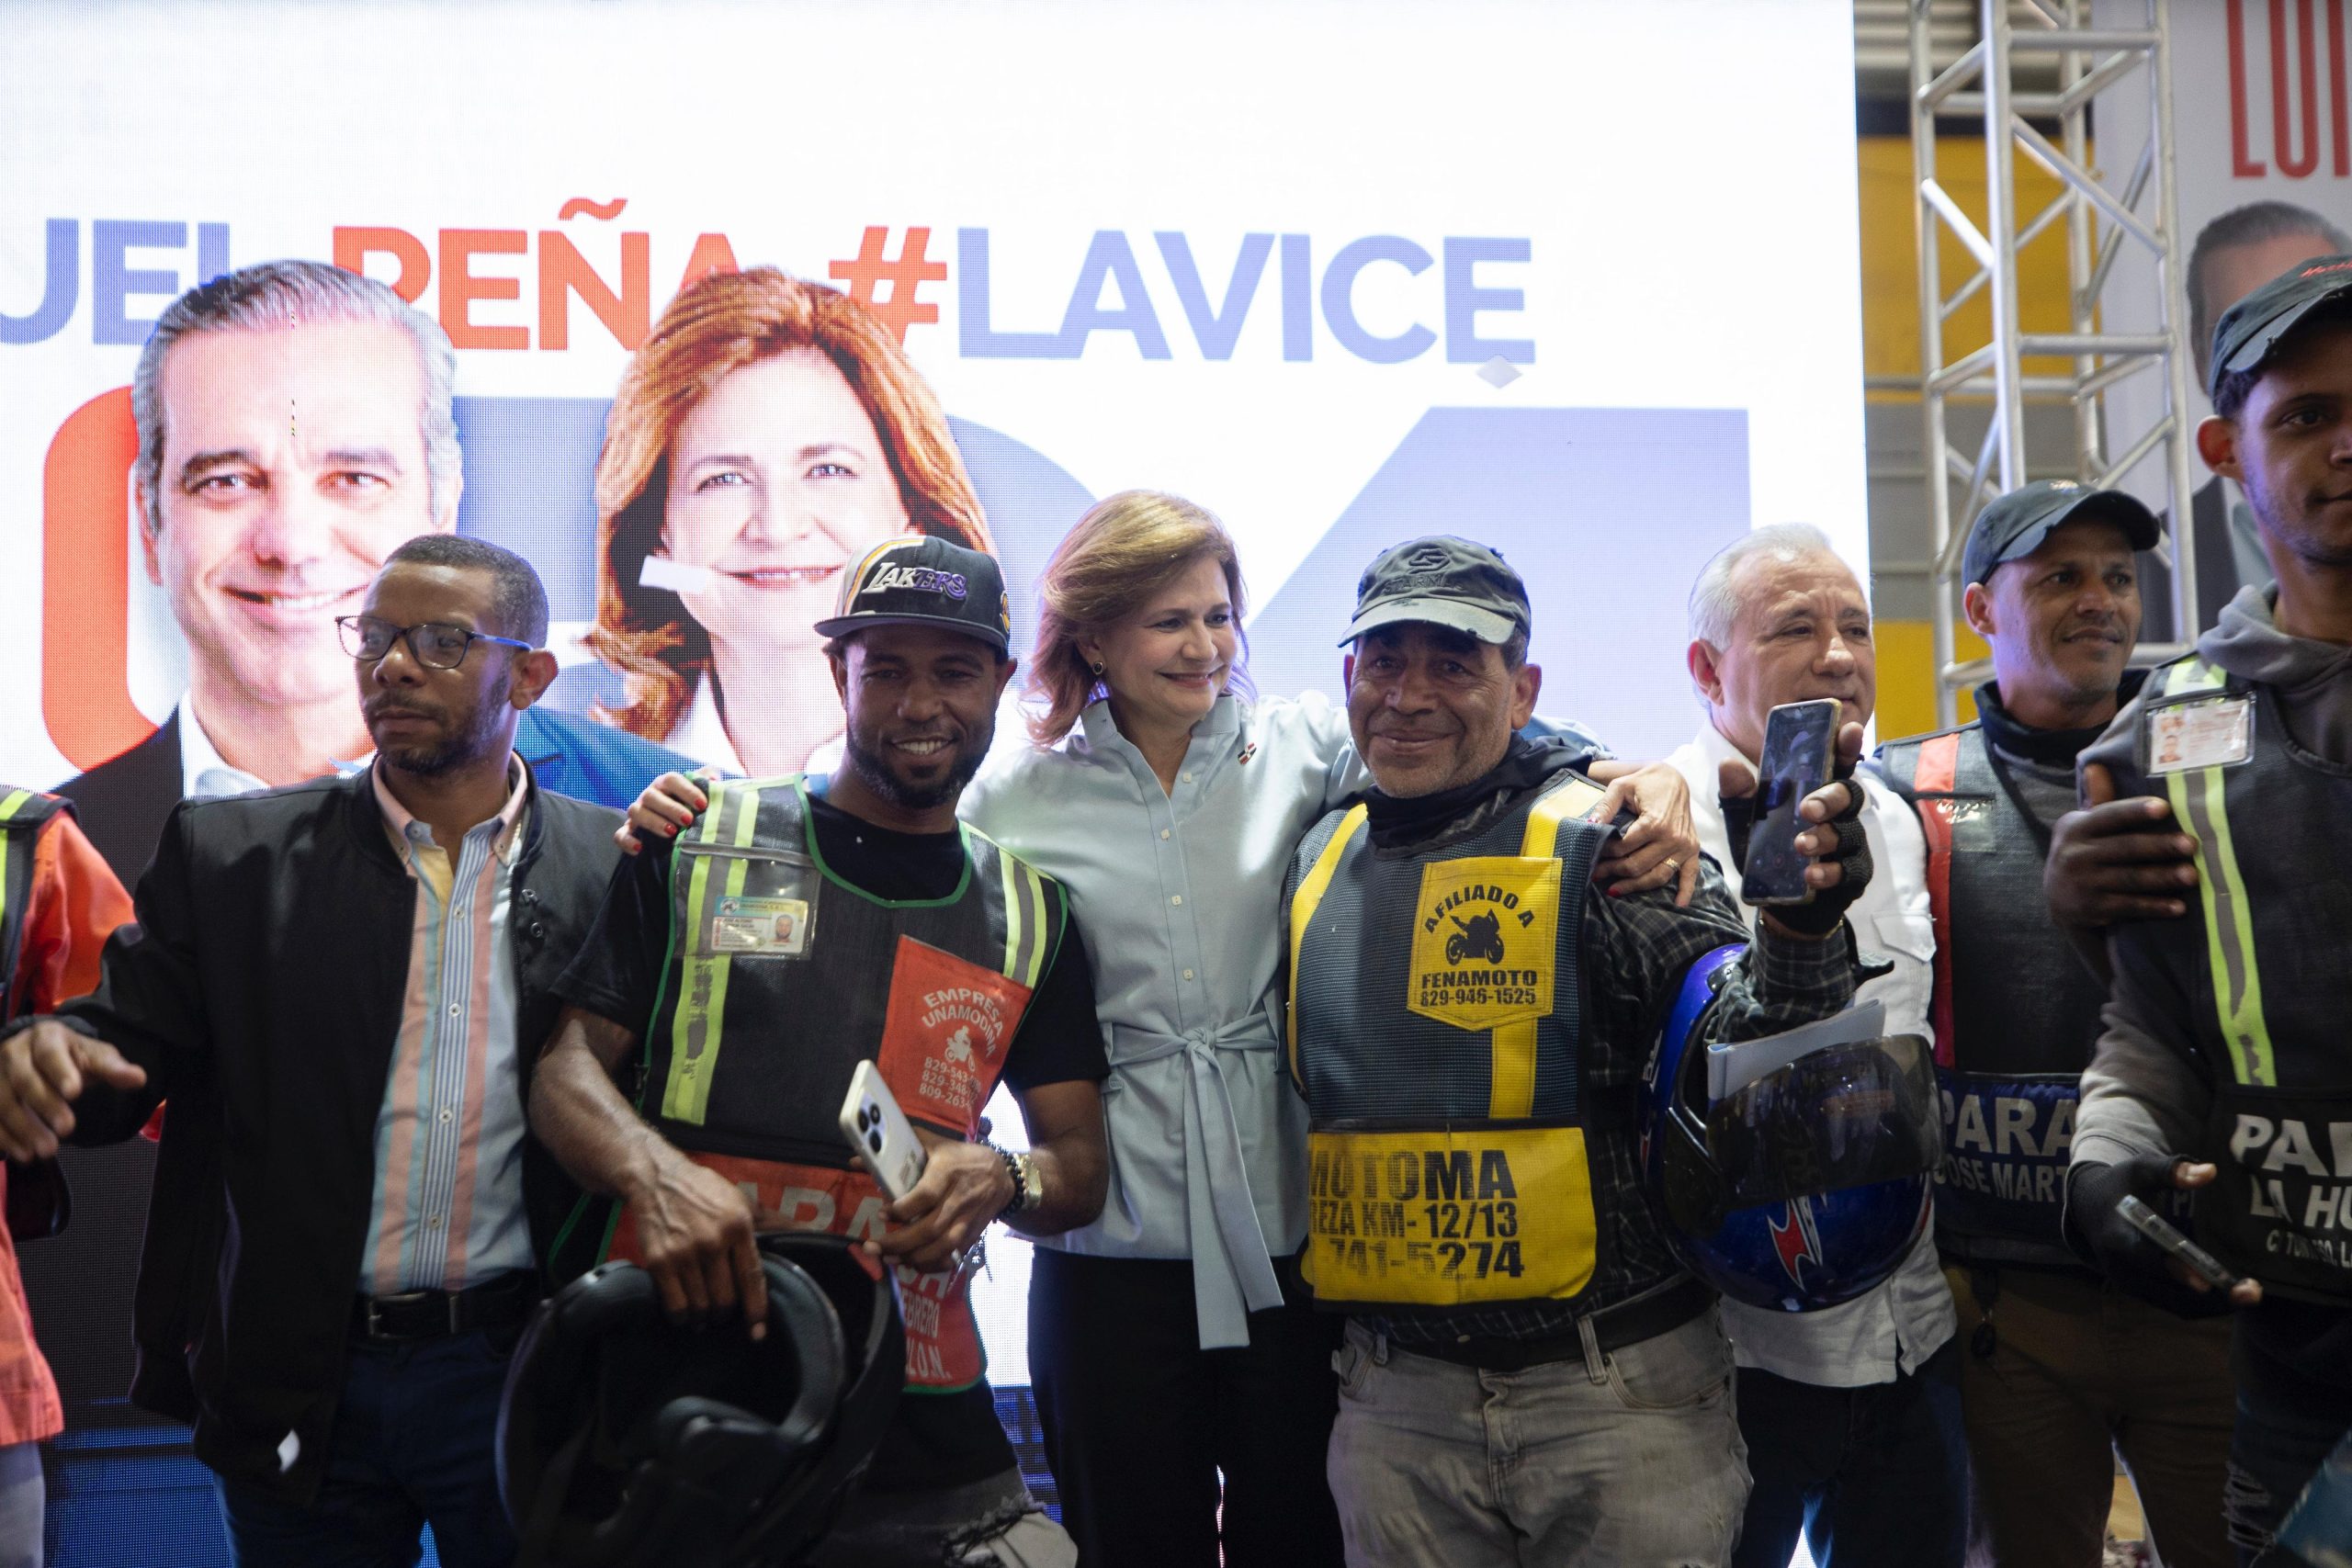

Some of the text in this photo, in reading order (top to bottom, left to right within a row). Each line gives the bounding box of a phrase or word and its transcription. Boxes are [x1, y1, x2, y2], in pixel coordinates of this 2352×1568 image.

[861, 562, 967, 601] LAKERS
[1425, 885, 1535, 933] AFILIADO A
[1421, 969, 1538, 989] FENAMOTO
[923, 987, 1004, 1037] EMPRESA
[1424, 1201, 1518, 1238] 12/13
